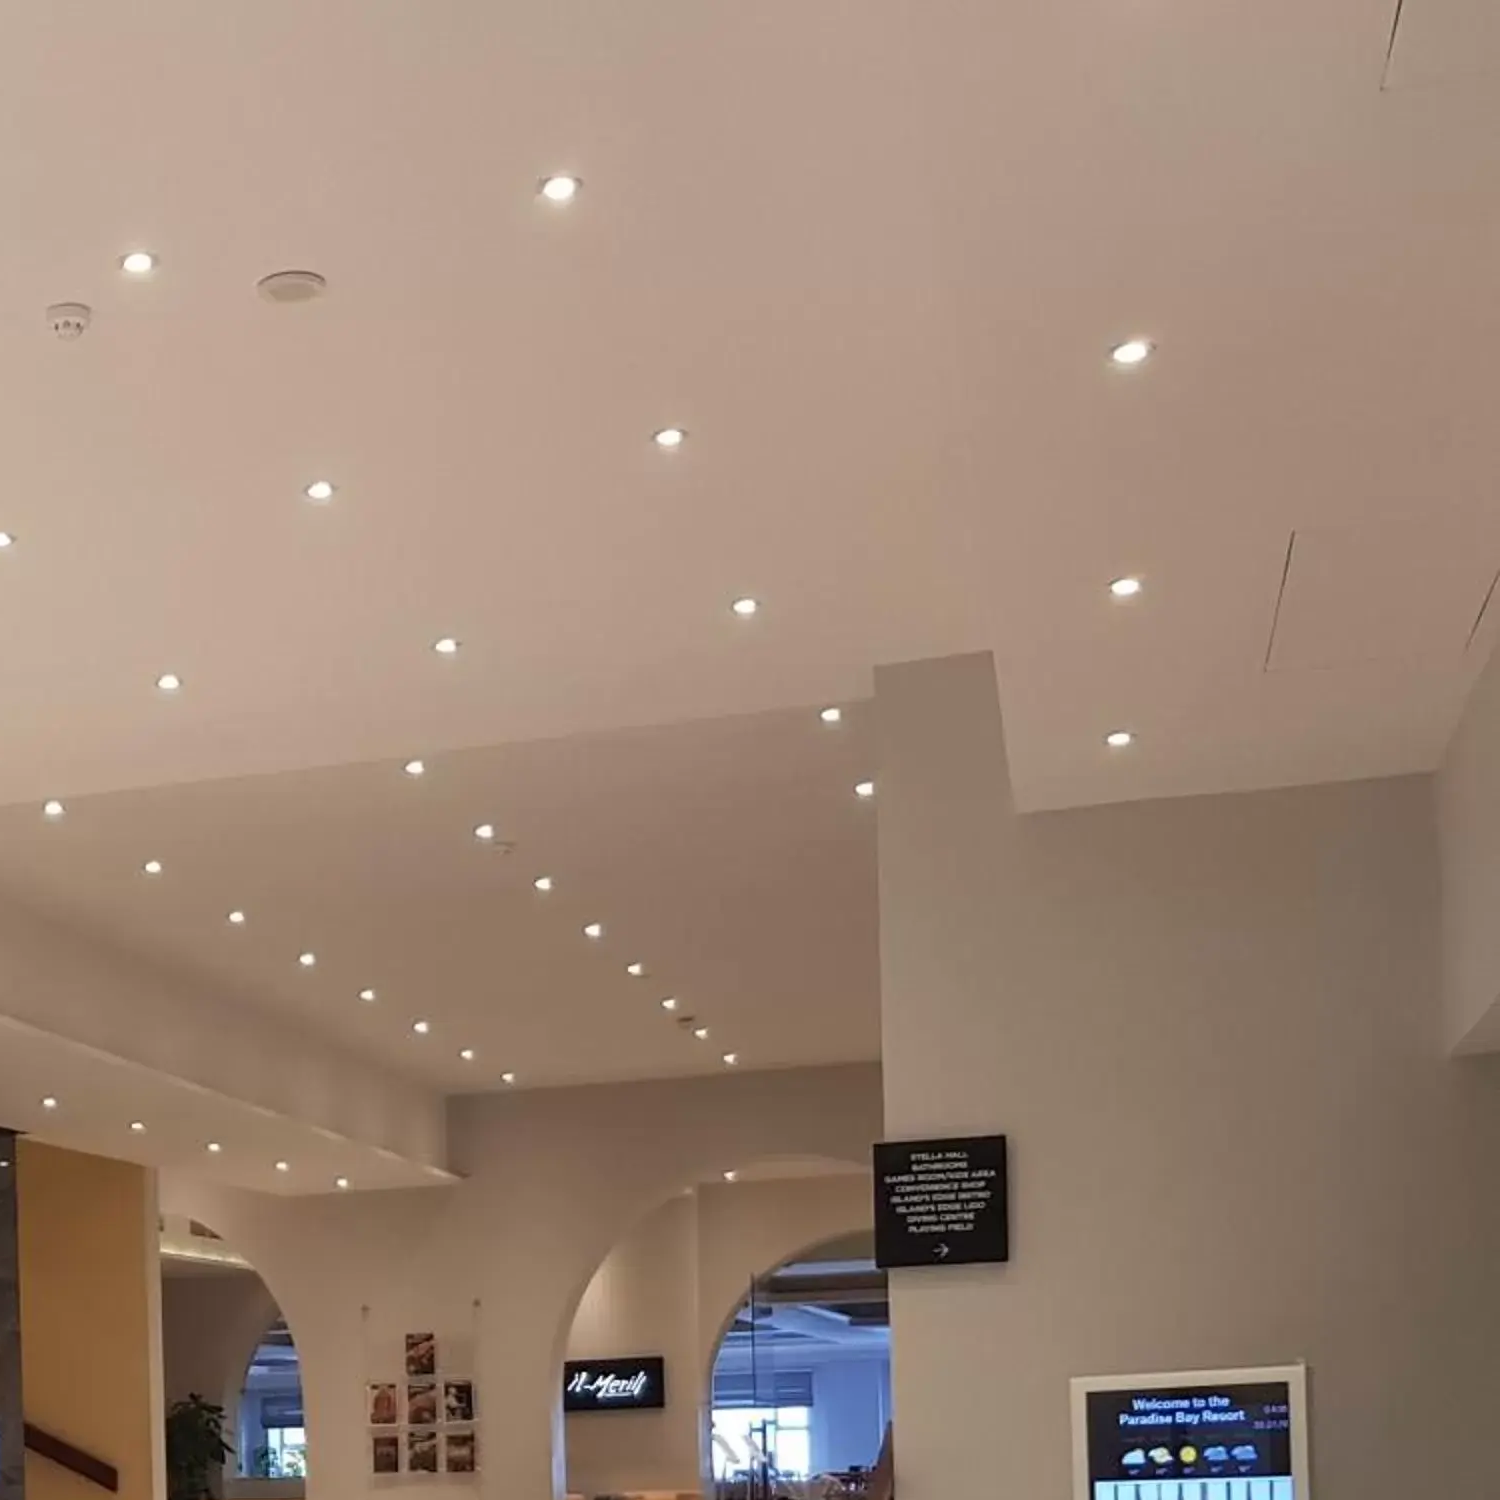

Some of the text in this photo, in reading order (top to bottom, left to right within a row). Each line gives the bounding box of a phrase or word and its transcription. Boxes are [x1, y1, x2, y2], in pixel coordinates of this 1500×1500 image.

[1132, 1396, 1230, 1411] Welcome to the
[1119, 1410, 1245, 1426] Paradise Bay Resort
